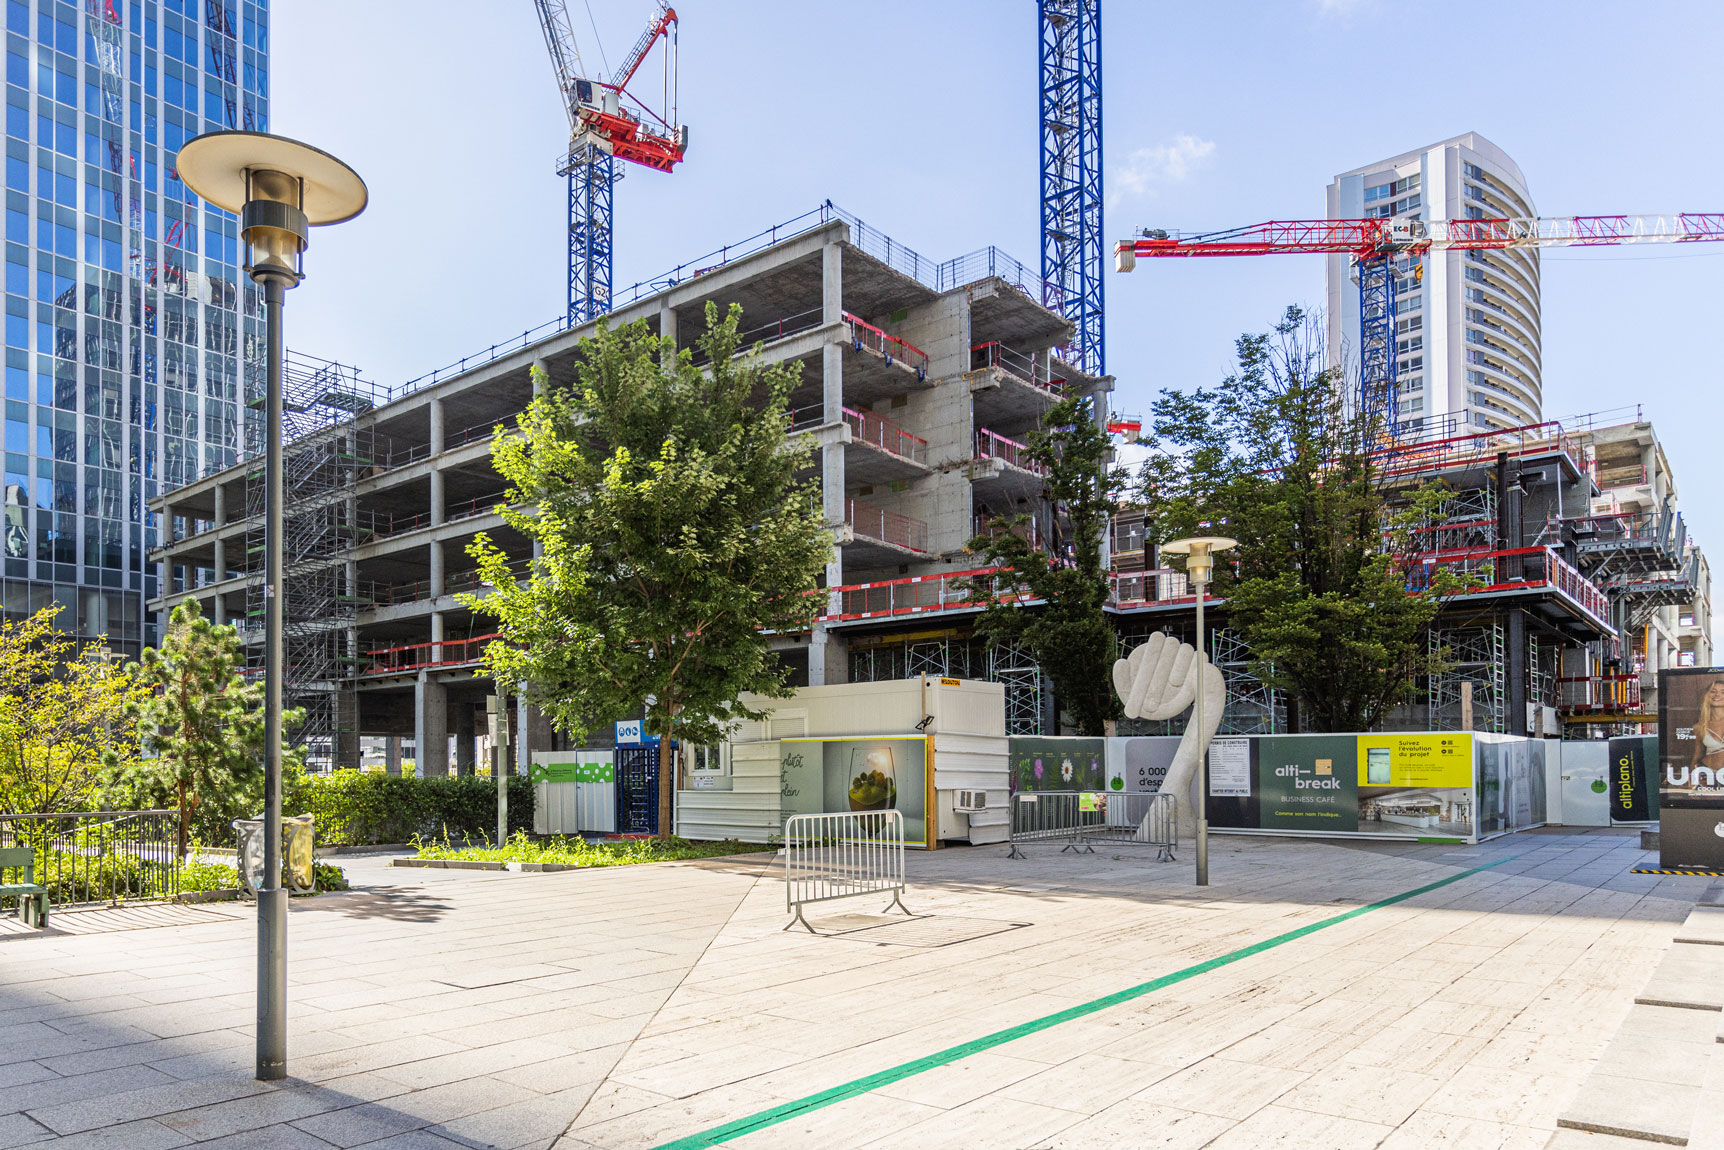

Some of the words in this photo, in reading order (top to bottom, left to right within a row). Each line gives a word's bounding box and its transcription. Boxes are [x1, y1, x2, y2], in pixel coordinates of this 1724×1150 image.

[595, 286, 606, 298] G2
[1139, 767, 1145, 776] 6
[1148, 767, 1167, 776] 000
[1295, 777, 1341, 789] break
[1618, 754, 1634, 809] altiplano.
[1281, 795, 1314, 803] BUSINESS
[1316, 795, 1336, 803] CAFÉ
